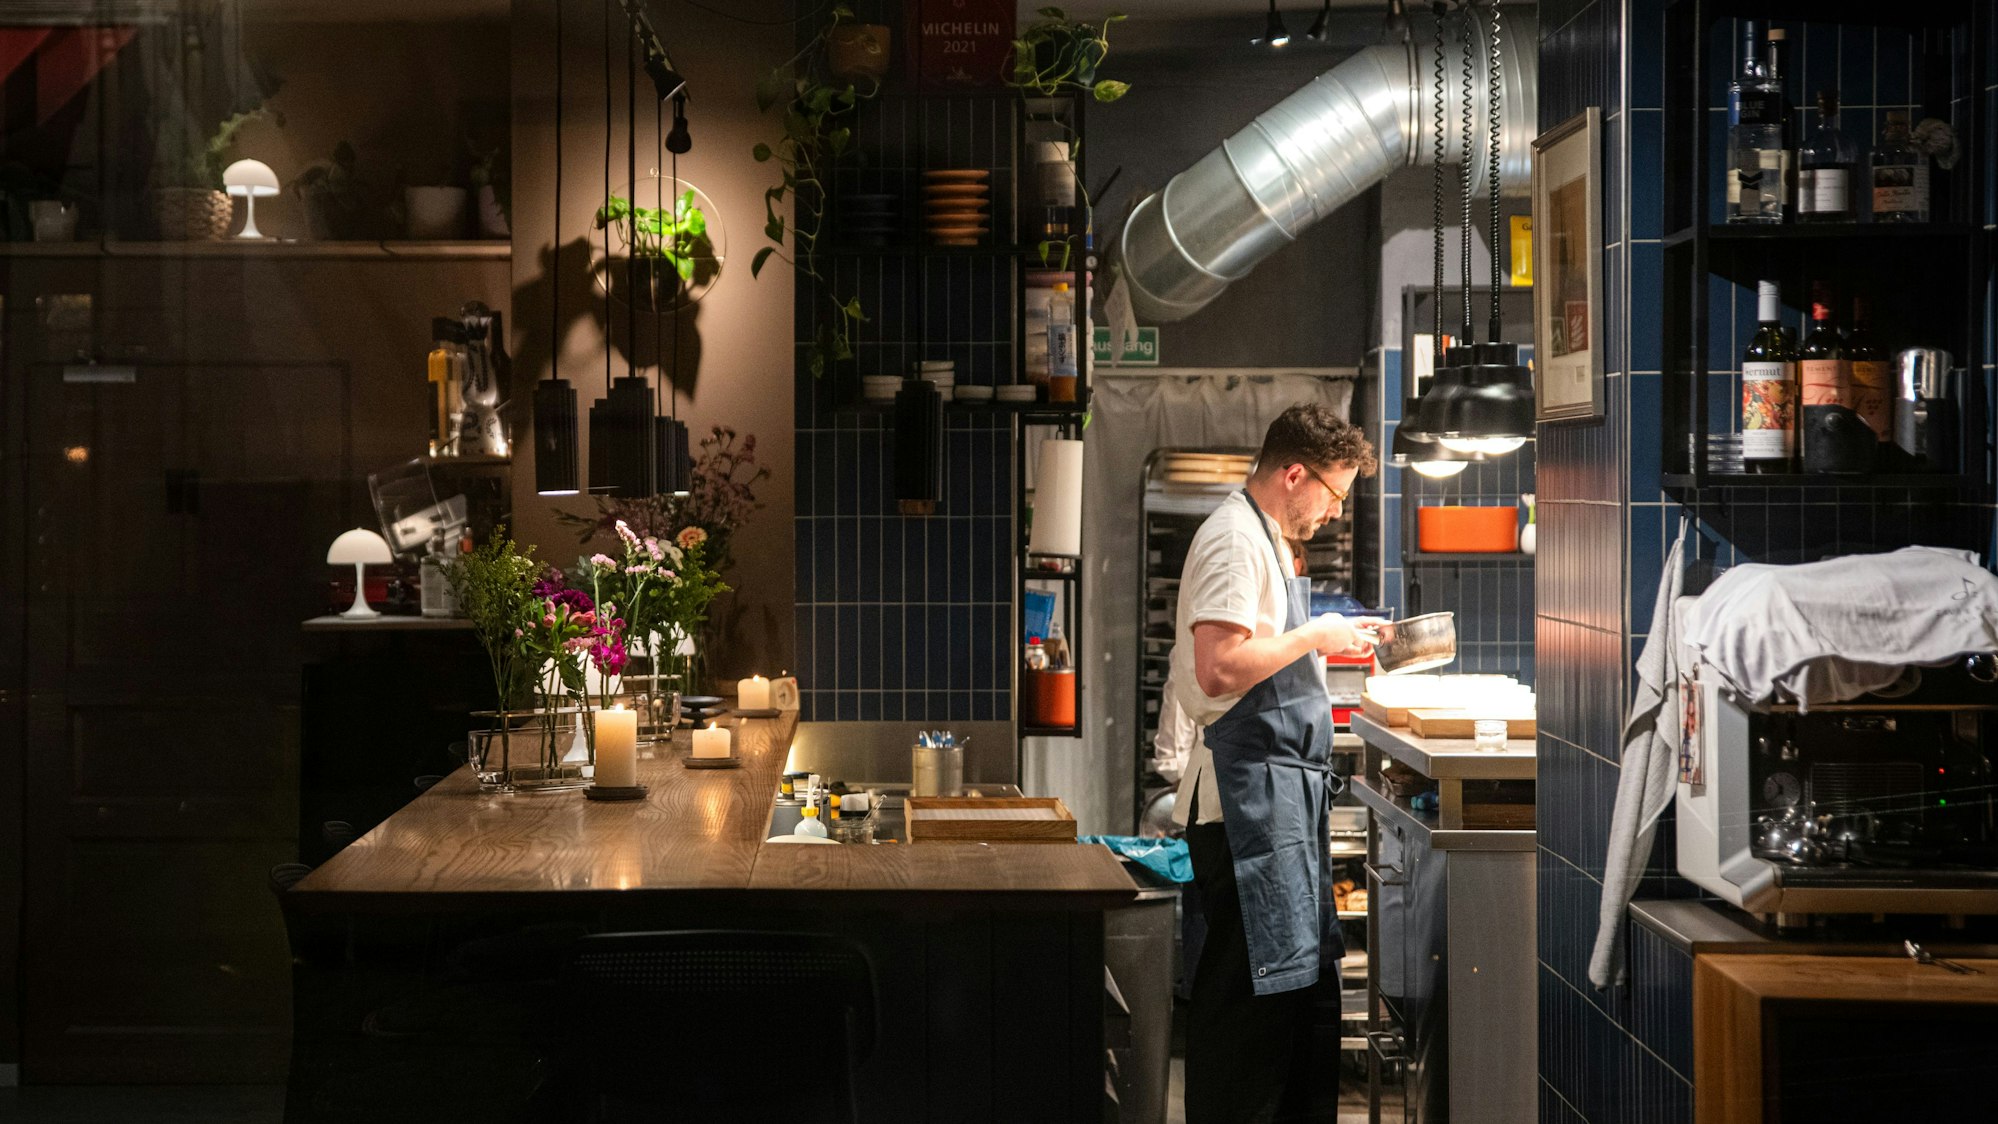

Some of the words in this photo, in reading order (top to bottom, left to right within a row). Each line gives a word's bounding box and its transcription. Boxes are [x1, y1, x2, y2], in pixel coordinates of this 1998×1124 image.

[922, 22, 999, 35] MICHELIN
[943, 40, 976, 53] 2021
[1093, 341, 1153, 355] usang
